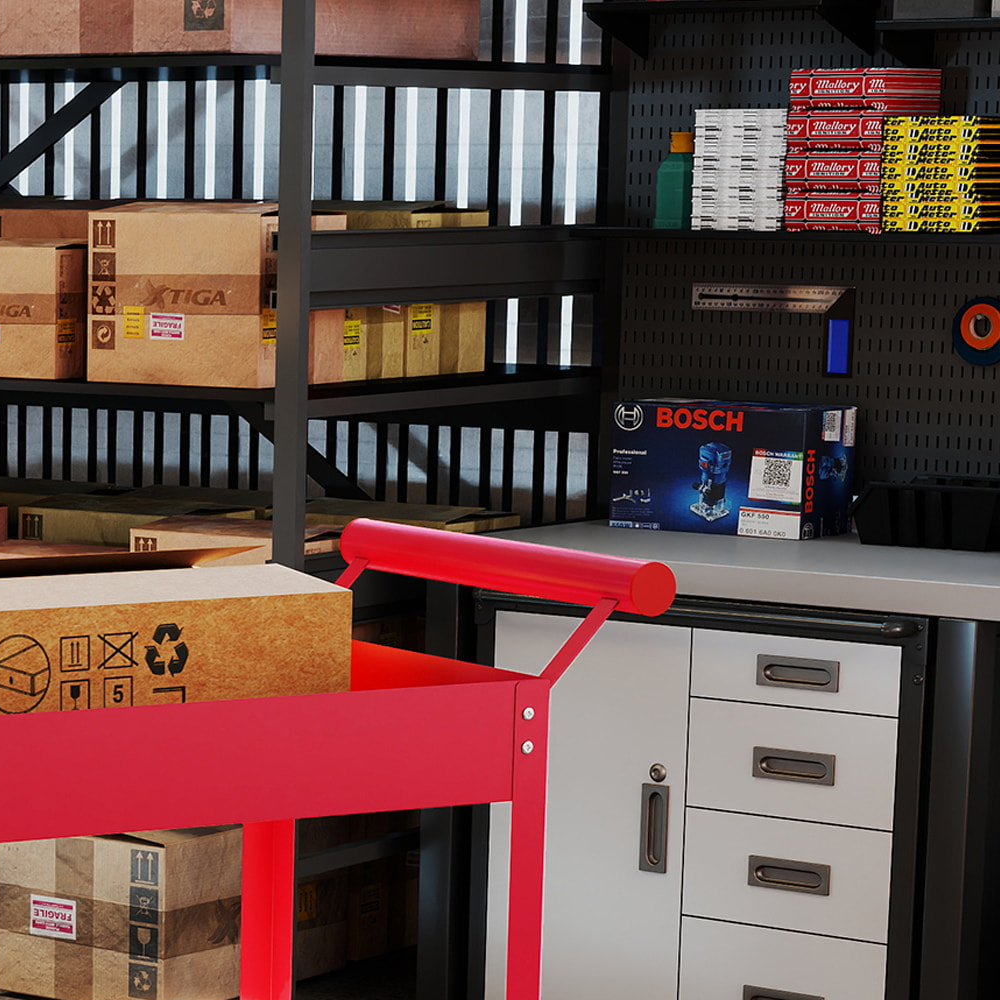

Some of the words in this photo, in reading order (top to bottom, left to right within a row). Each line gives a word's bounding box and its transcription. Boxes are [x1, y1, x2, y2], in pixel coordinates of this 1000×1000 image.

[816, 79, 860, 91] Mallory
[813, 121, 857, 133] Mallory
[811, 162, 855, 174] Mallory
[811, 203, 854, 215] Mallory
[656, 406, 744, 432] BOSCH
[805, 450, 816, 513] BOSCH
[112, 684, 124, 703] 5
[33, 908, 72, 922] FRAGILE
